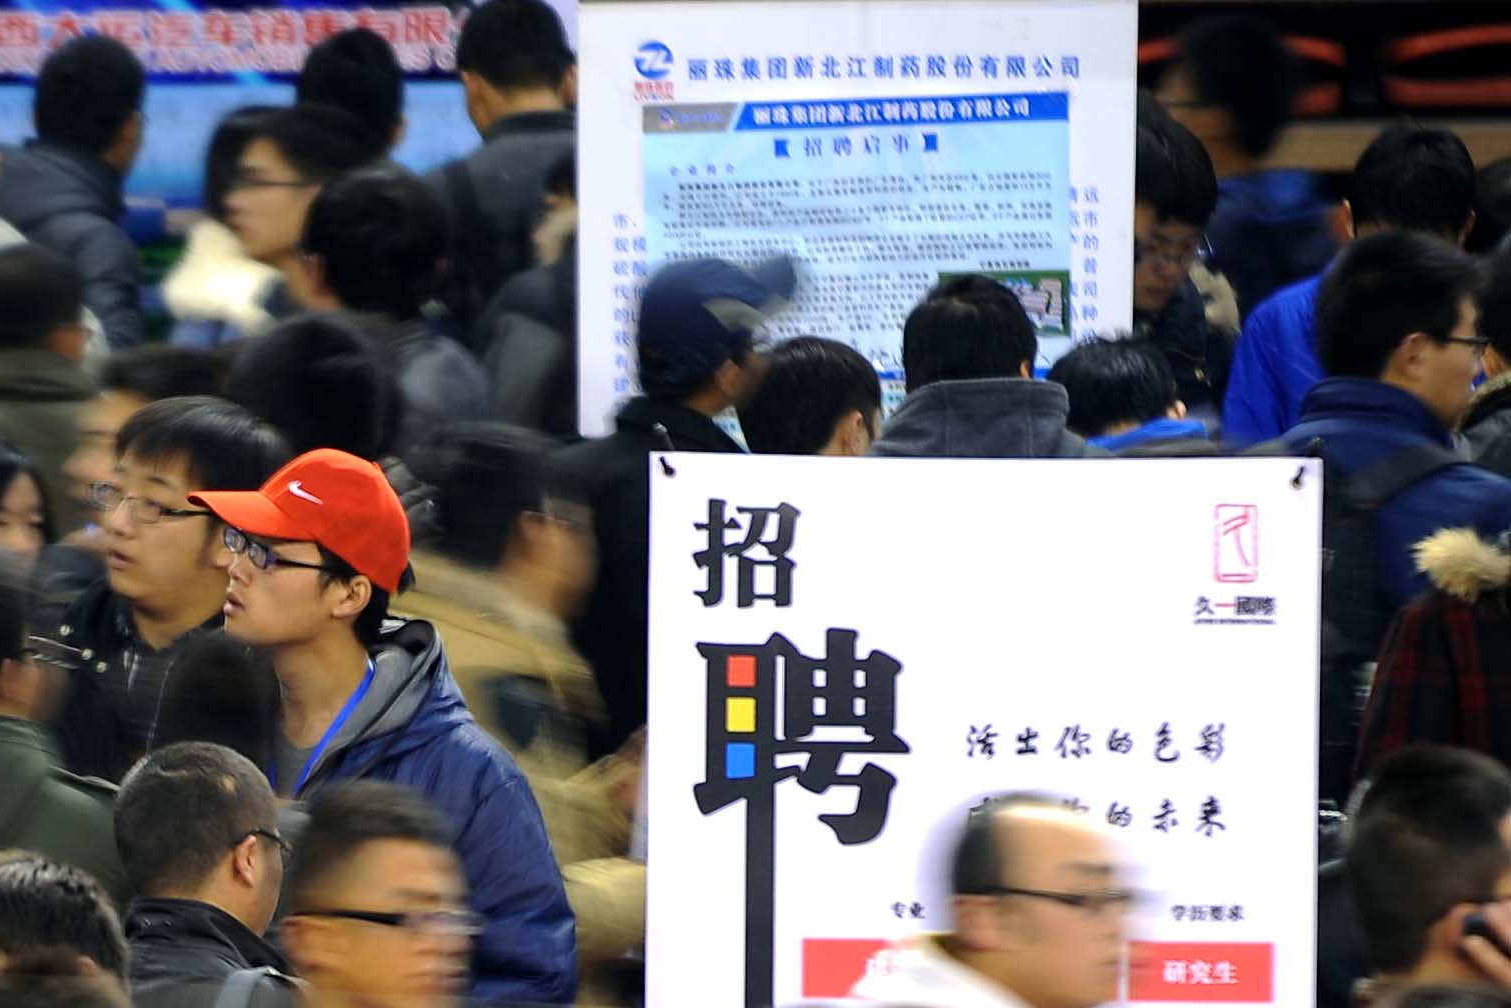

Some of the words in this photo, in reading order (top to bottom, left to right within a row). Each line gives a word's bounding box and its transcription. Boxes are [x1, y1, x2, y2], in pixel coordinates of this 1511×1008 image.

[688, 56, 1081, 80] 丽珠集团新北江制药股份有限公司
[752, 97, 1032, 126] 丽珠集团新北江制药股份有限公司
[803, 134, 911, 157] 招聘启事
[1194, 596, 1276, 615] 久一國際
[965, 721, 1227, 763] 活出你的色彩
[890, 901, 926, 919] 专业
[1170, 902, 1244, 922] 学历要求
[1162, 959, 1239, 985] 研究生
